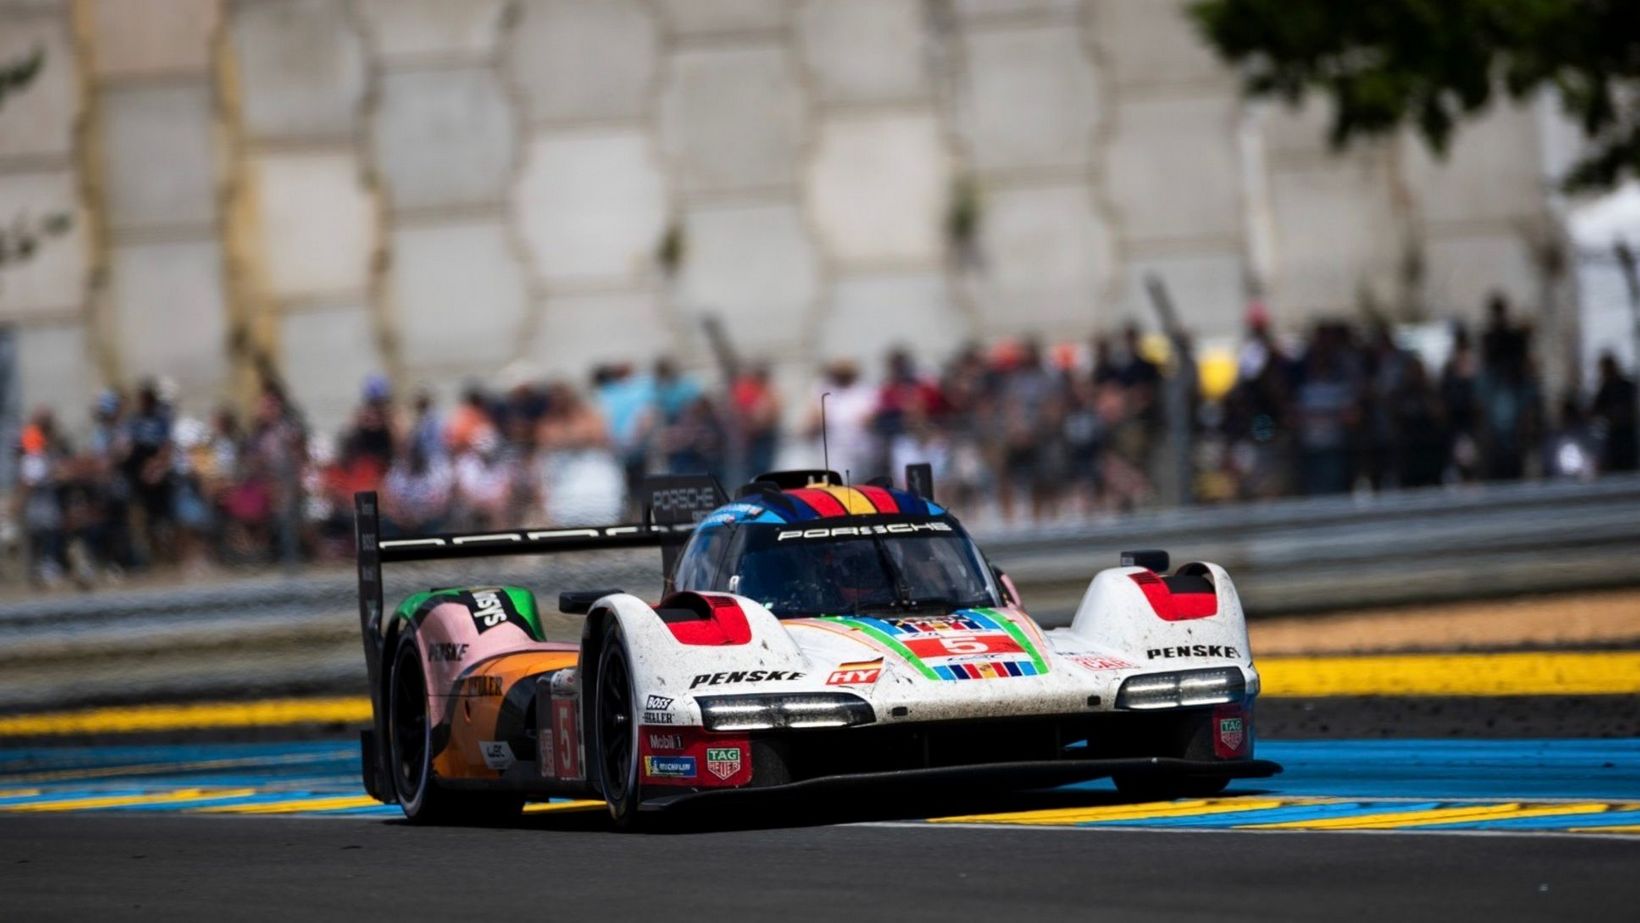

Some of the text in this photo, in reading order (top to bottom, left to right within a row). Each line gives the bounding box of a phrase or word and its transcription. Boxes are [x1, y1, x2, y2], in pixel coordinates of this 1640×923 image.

[652, 487, 714, 511] PORSCHE
[777, 521, 953, 541] PORSCHE
[938, 636, 990, 654] 5
[1146, 645, 1241, 659] PENSKE
[689, 671, 806, 689] PENSKE
[829, 668, 878, 683] HY
[647, 696, 670, 709] BOSS
[1223, 720, 1241, 730] TAG
[559, 707, 571, 769] 5
[649, 734, 674, 749] Mobil
[709, 750, 737, 760] TAG
[708, 762, 738, 777] HEUER
